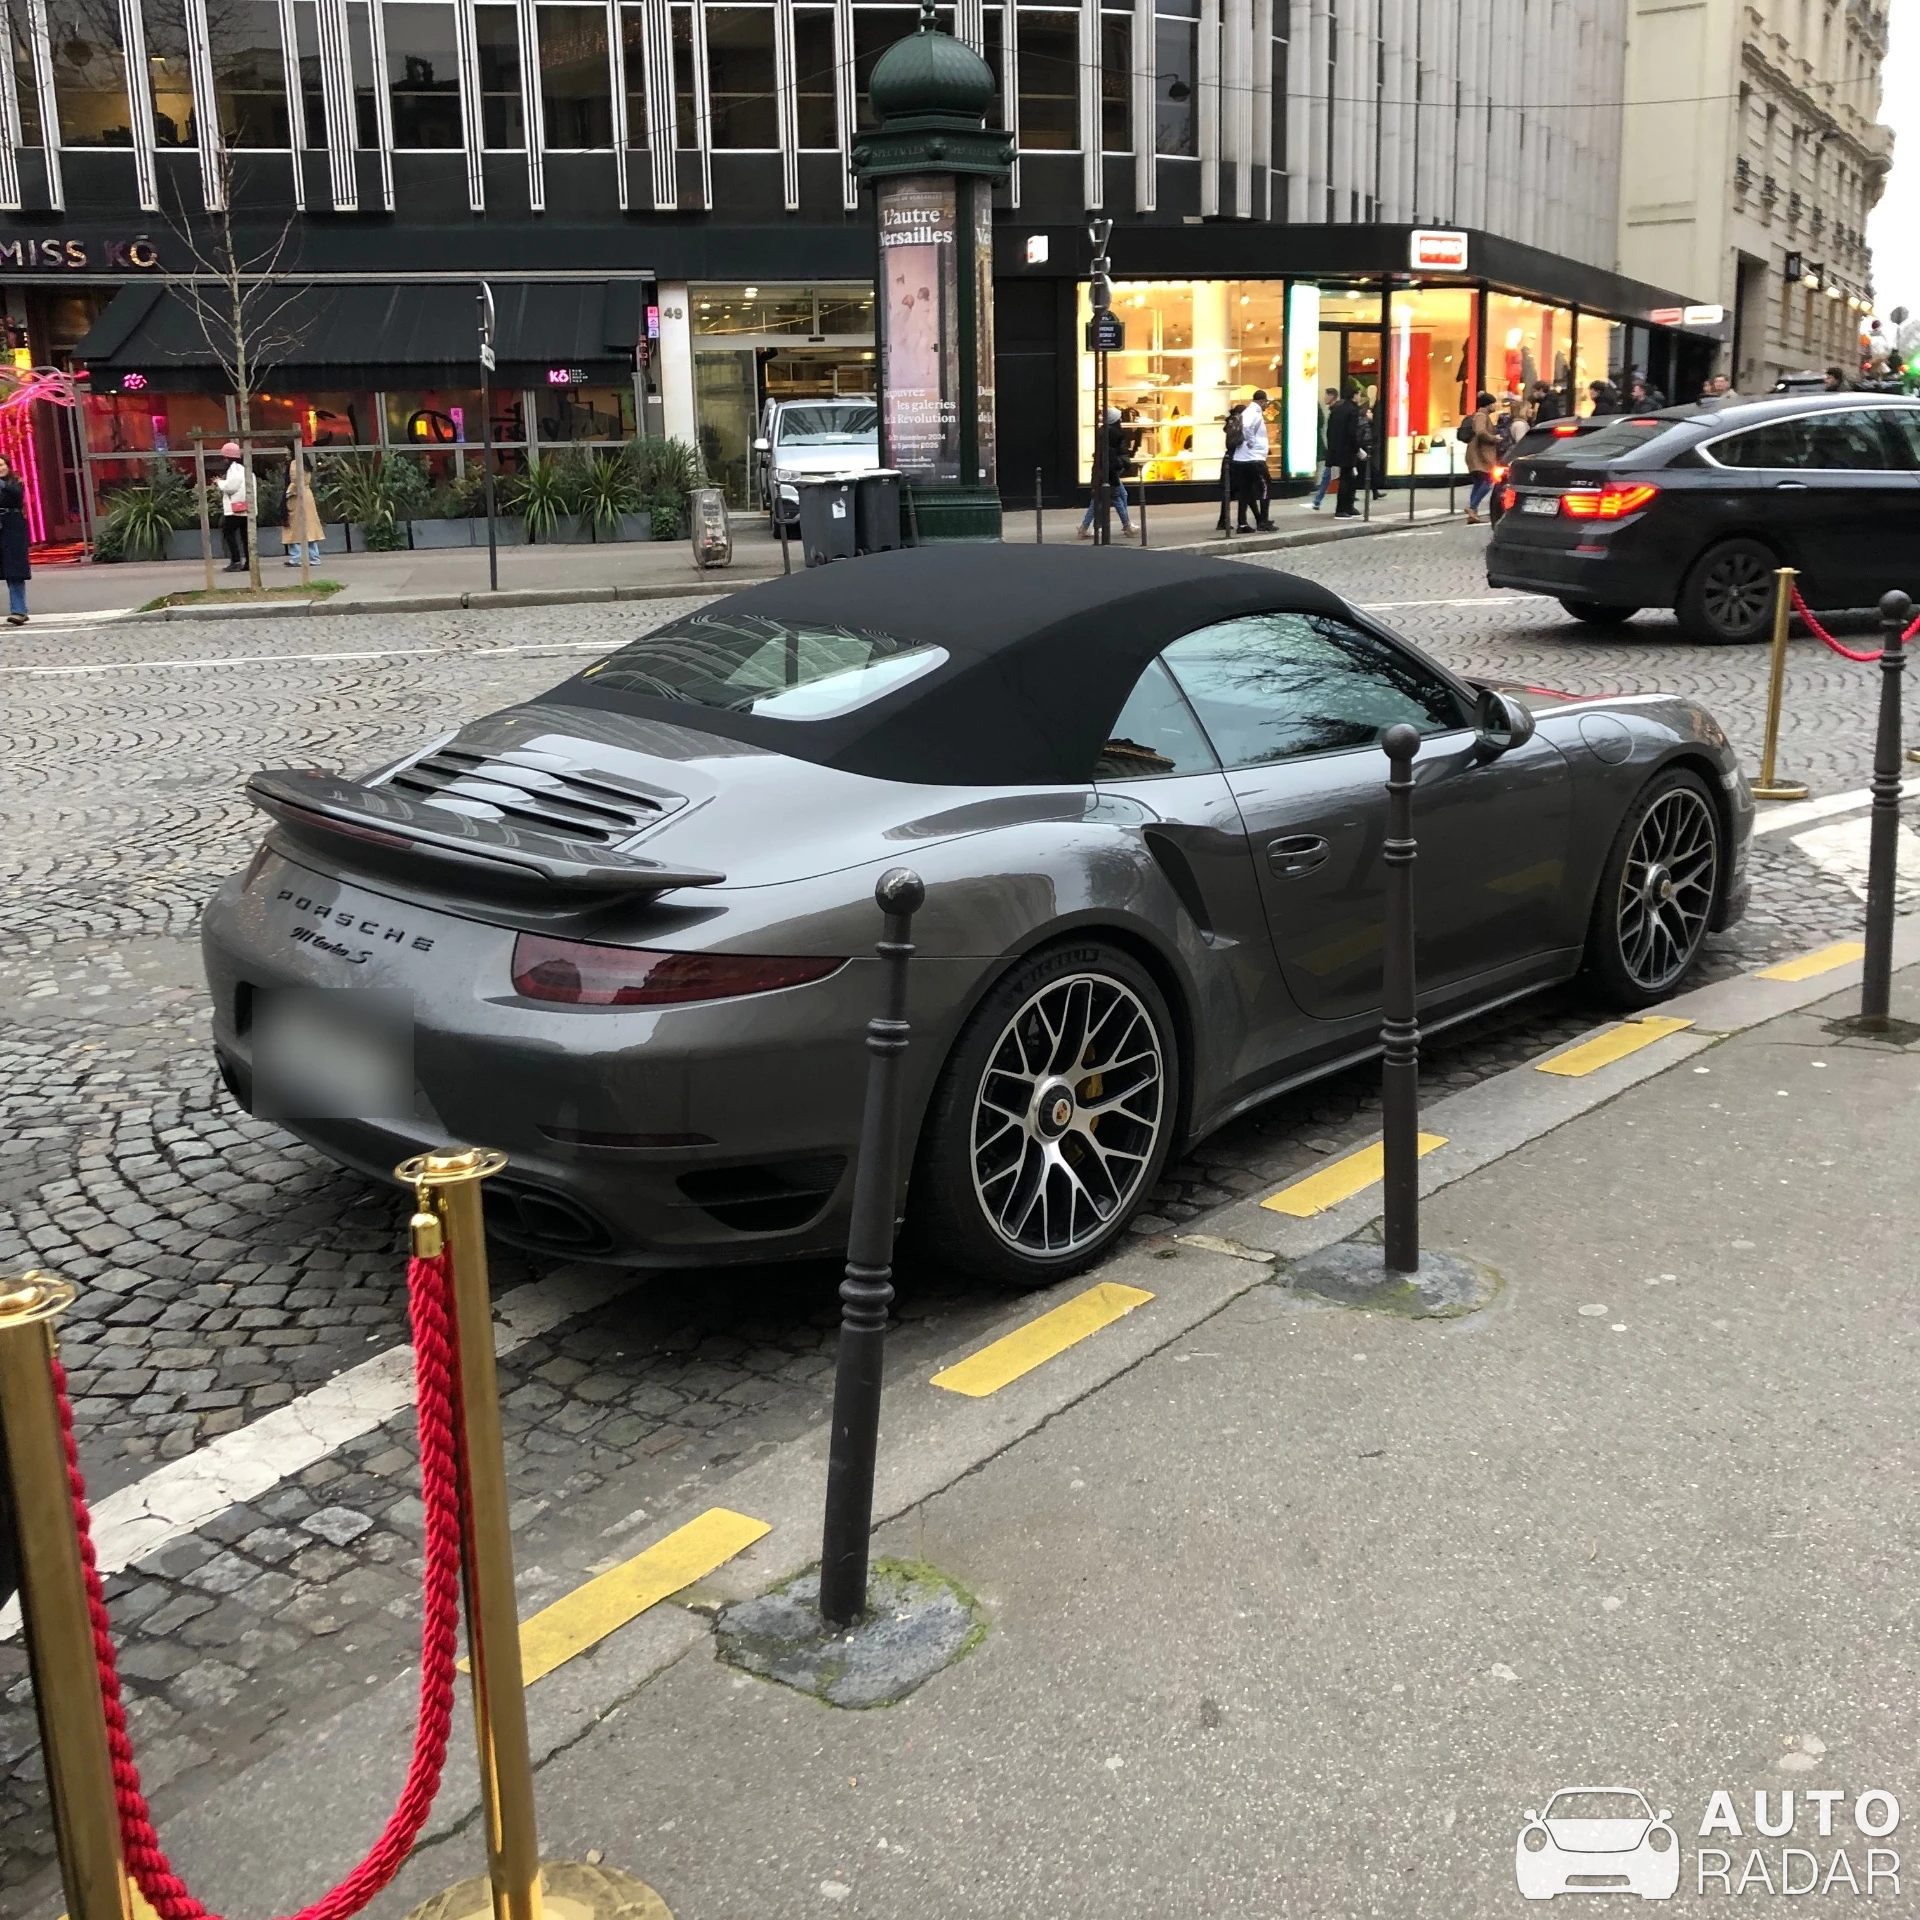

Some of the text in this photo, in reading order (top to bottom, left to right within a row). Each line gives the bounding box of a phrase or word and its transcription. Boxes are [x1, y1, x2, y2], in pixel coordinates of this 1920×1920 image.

[0, 239, 87, 267] MISS
[663, 307, 683, 320] 49
[897, 399, 956, 412] les galeries
[277, 889, 435, 952] PORSCHE
[346, 950, 373, 964] S
